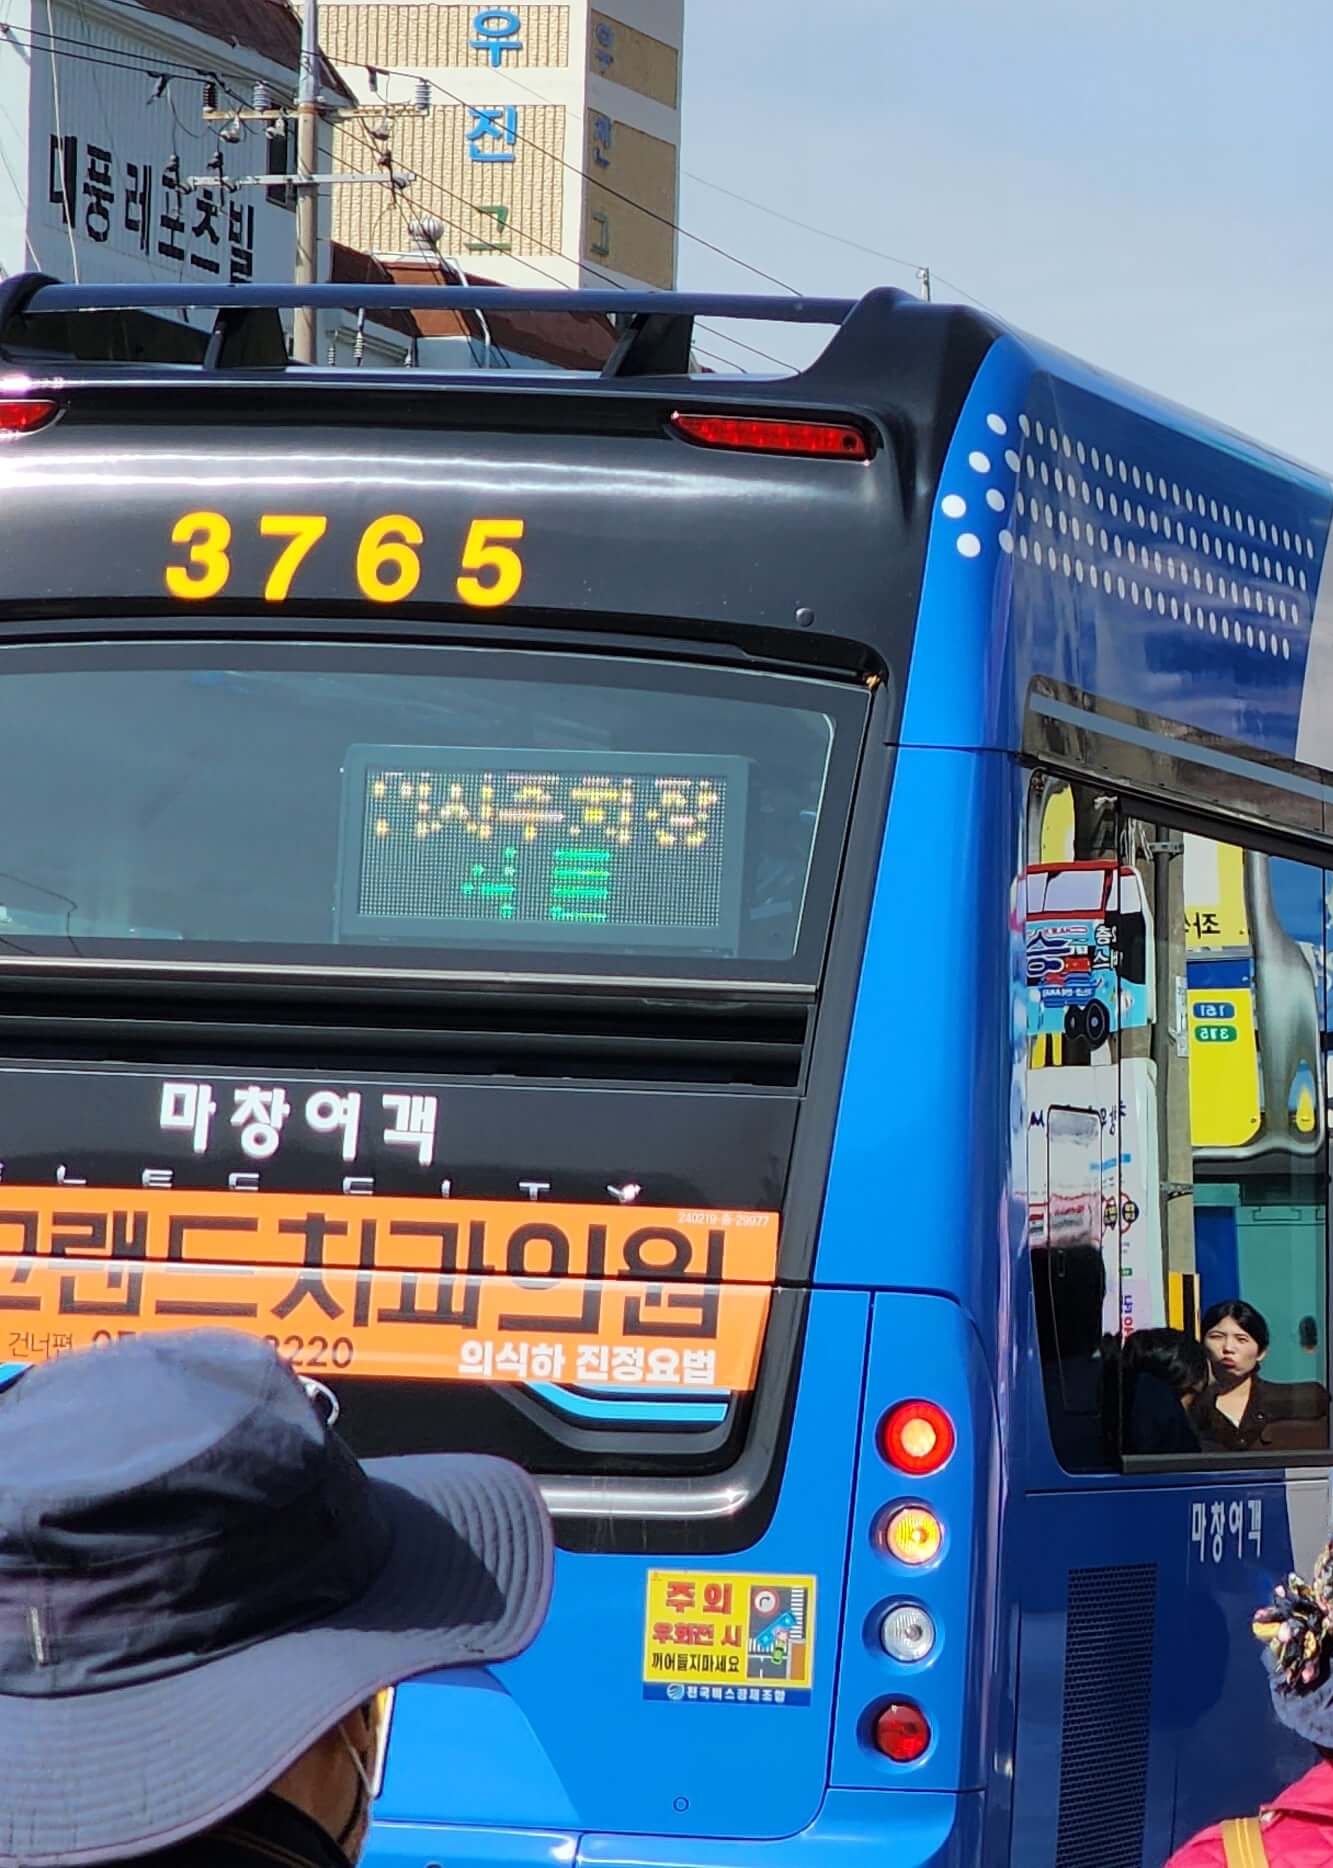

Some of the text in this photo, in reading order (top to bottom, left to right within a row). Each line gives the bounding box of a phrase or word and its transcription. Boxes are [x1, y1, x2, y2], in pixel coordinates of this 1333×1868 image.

[165, 511, 525, 607] 3765
[160, 1082, 439, 1168] 마창여객
[458, 1340, 717, 1386] 의식하 진정요법
[1191, 1497, 1263, 1564] 마창여객
[721, 1625, 743, 1648] 시
